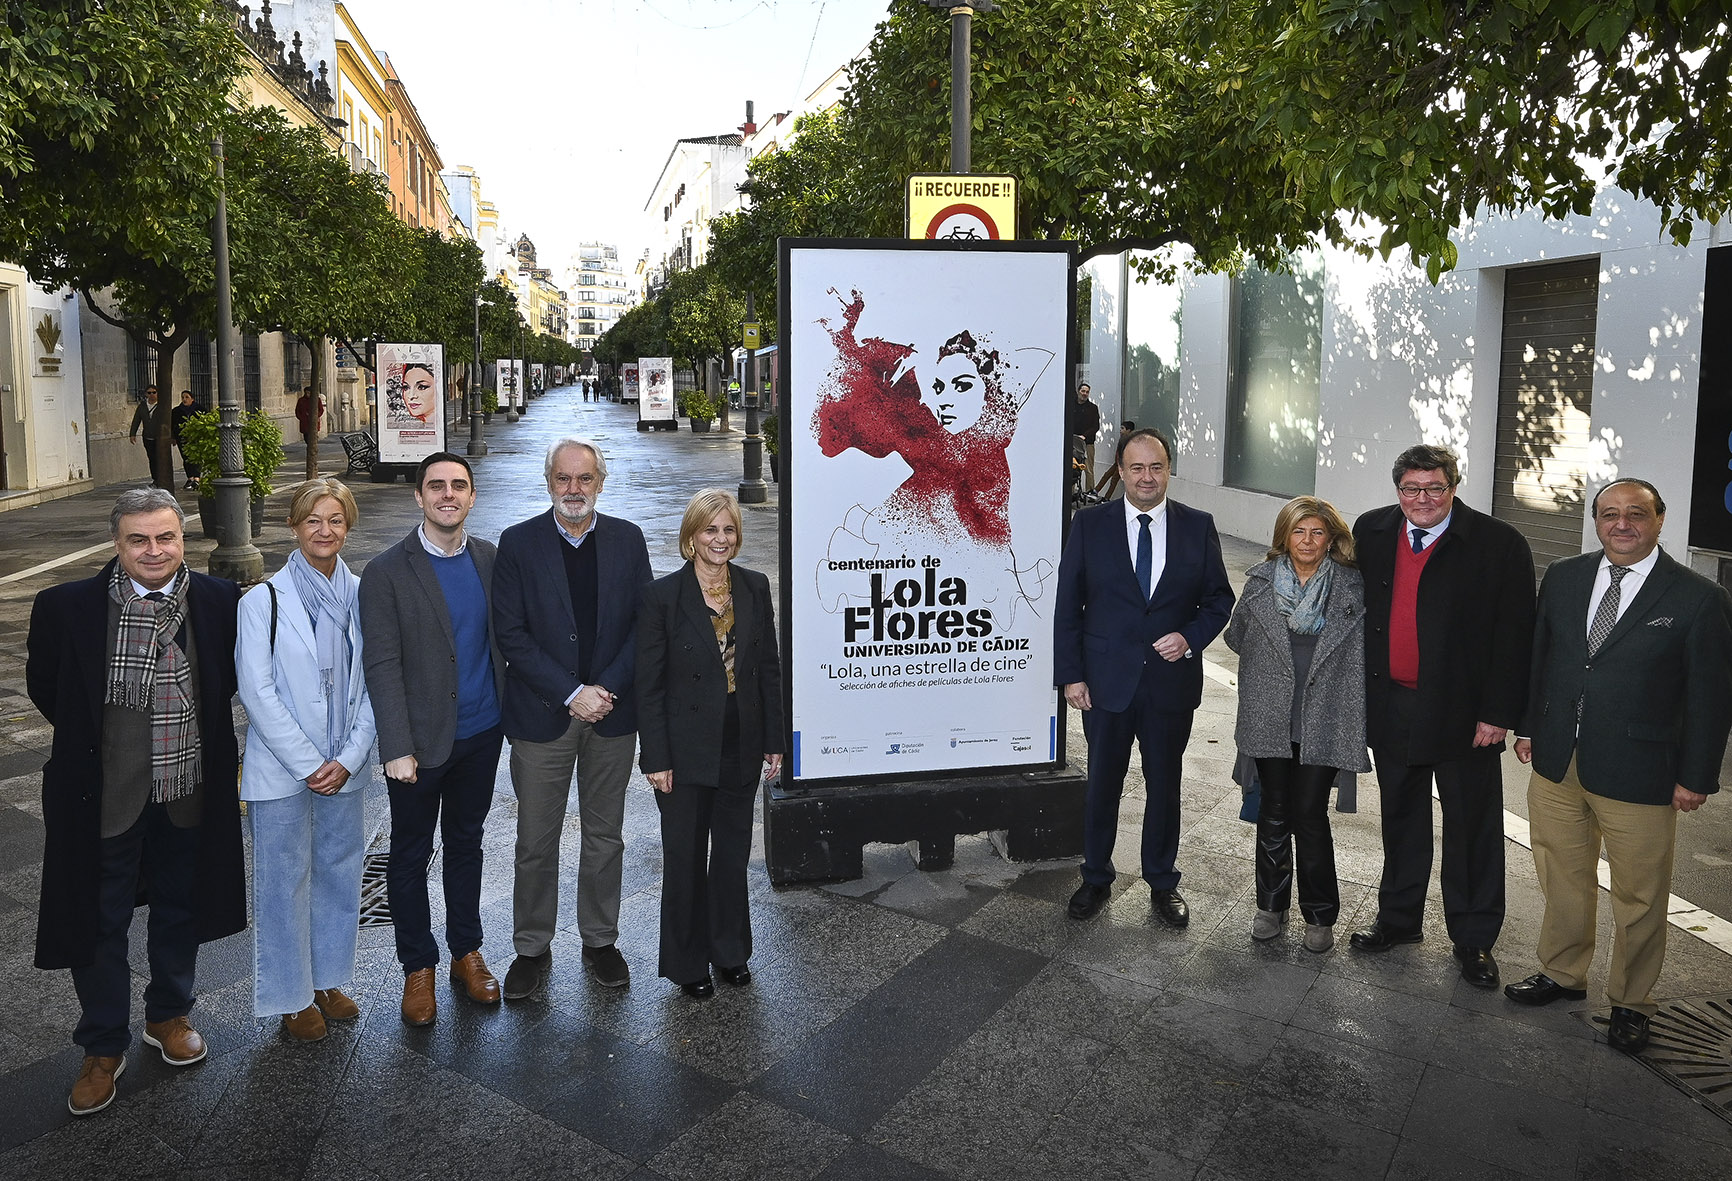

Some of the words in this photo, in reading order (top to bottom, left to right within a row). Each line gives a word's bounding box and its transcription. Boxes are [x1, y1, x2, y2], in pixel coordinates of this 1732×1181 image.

[828, 553, 916, 571] centenario
[921, 554, 941, 568] de
[871, 568, 967, 608] Lola
[844, 607, 993, 643] Flores
[844, 642, 951, 658] UNIVERSIDAD
[957, 641, 977, 653] DE
[982, 636, 1029, 651] CÁDIZ
[871, 664, 901, 677] una
[905, 658, 966, 675] estrella
[970, 656, 990, 672] de
[840, 682, 876, 691] Selección
[877, 681, 888, 689] de
[888, 679, 916, 689] afiches
[917, 678, 928, 687] de
[963, 676, 973, 684] de
[974, 676, 990, 684] Lola
[991, 674, 1014, 683] Flores
